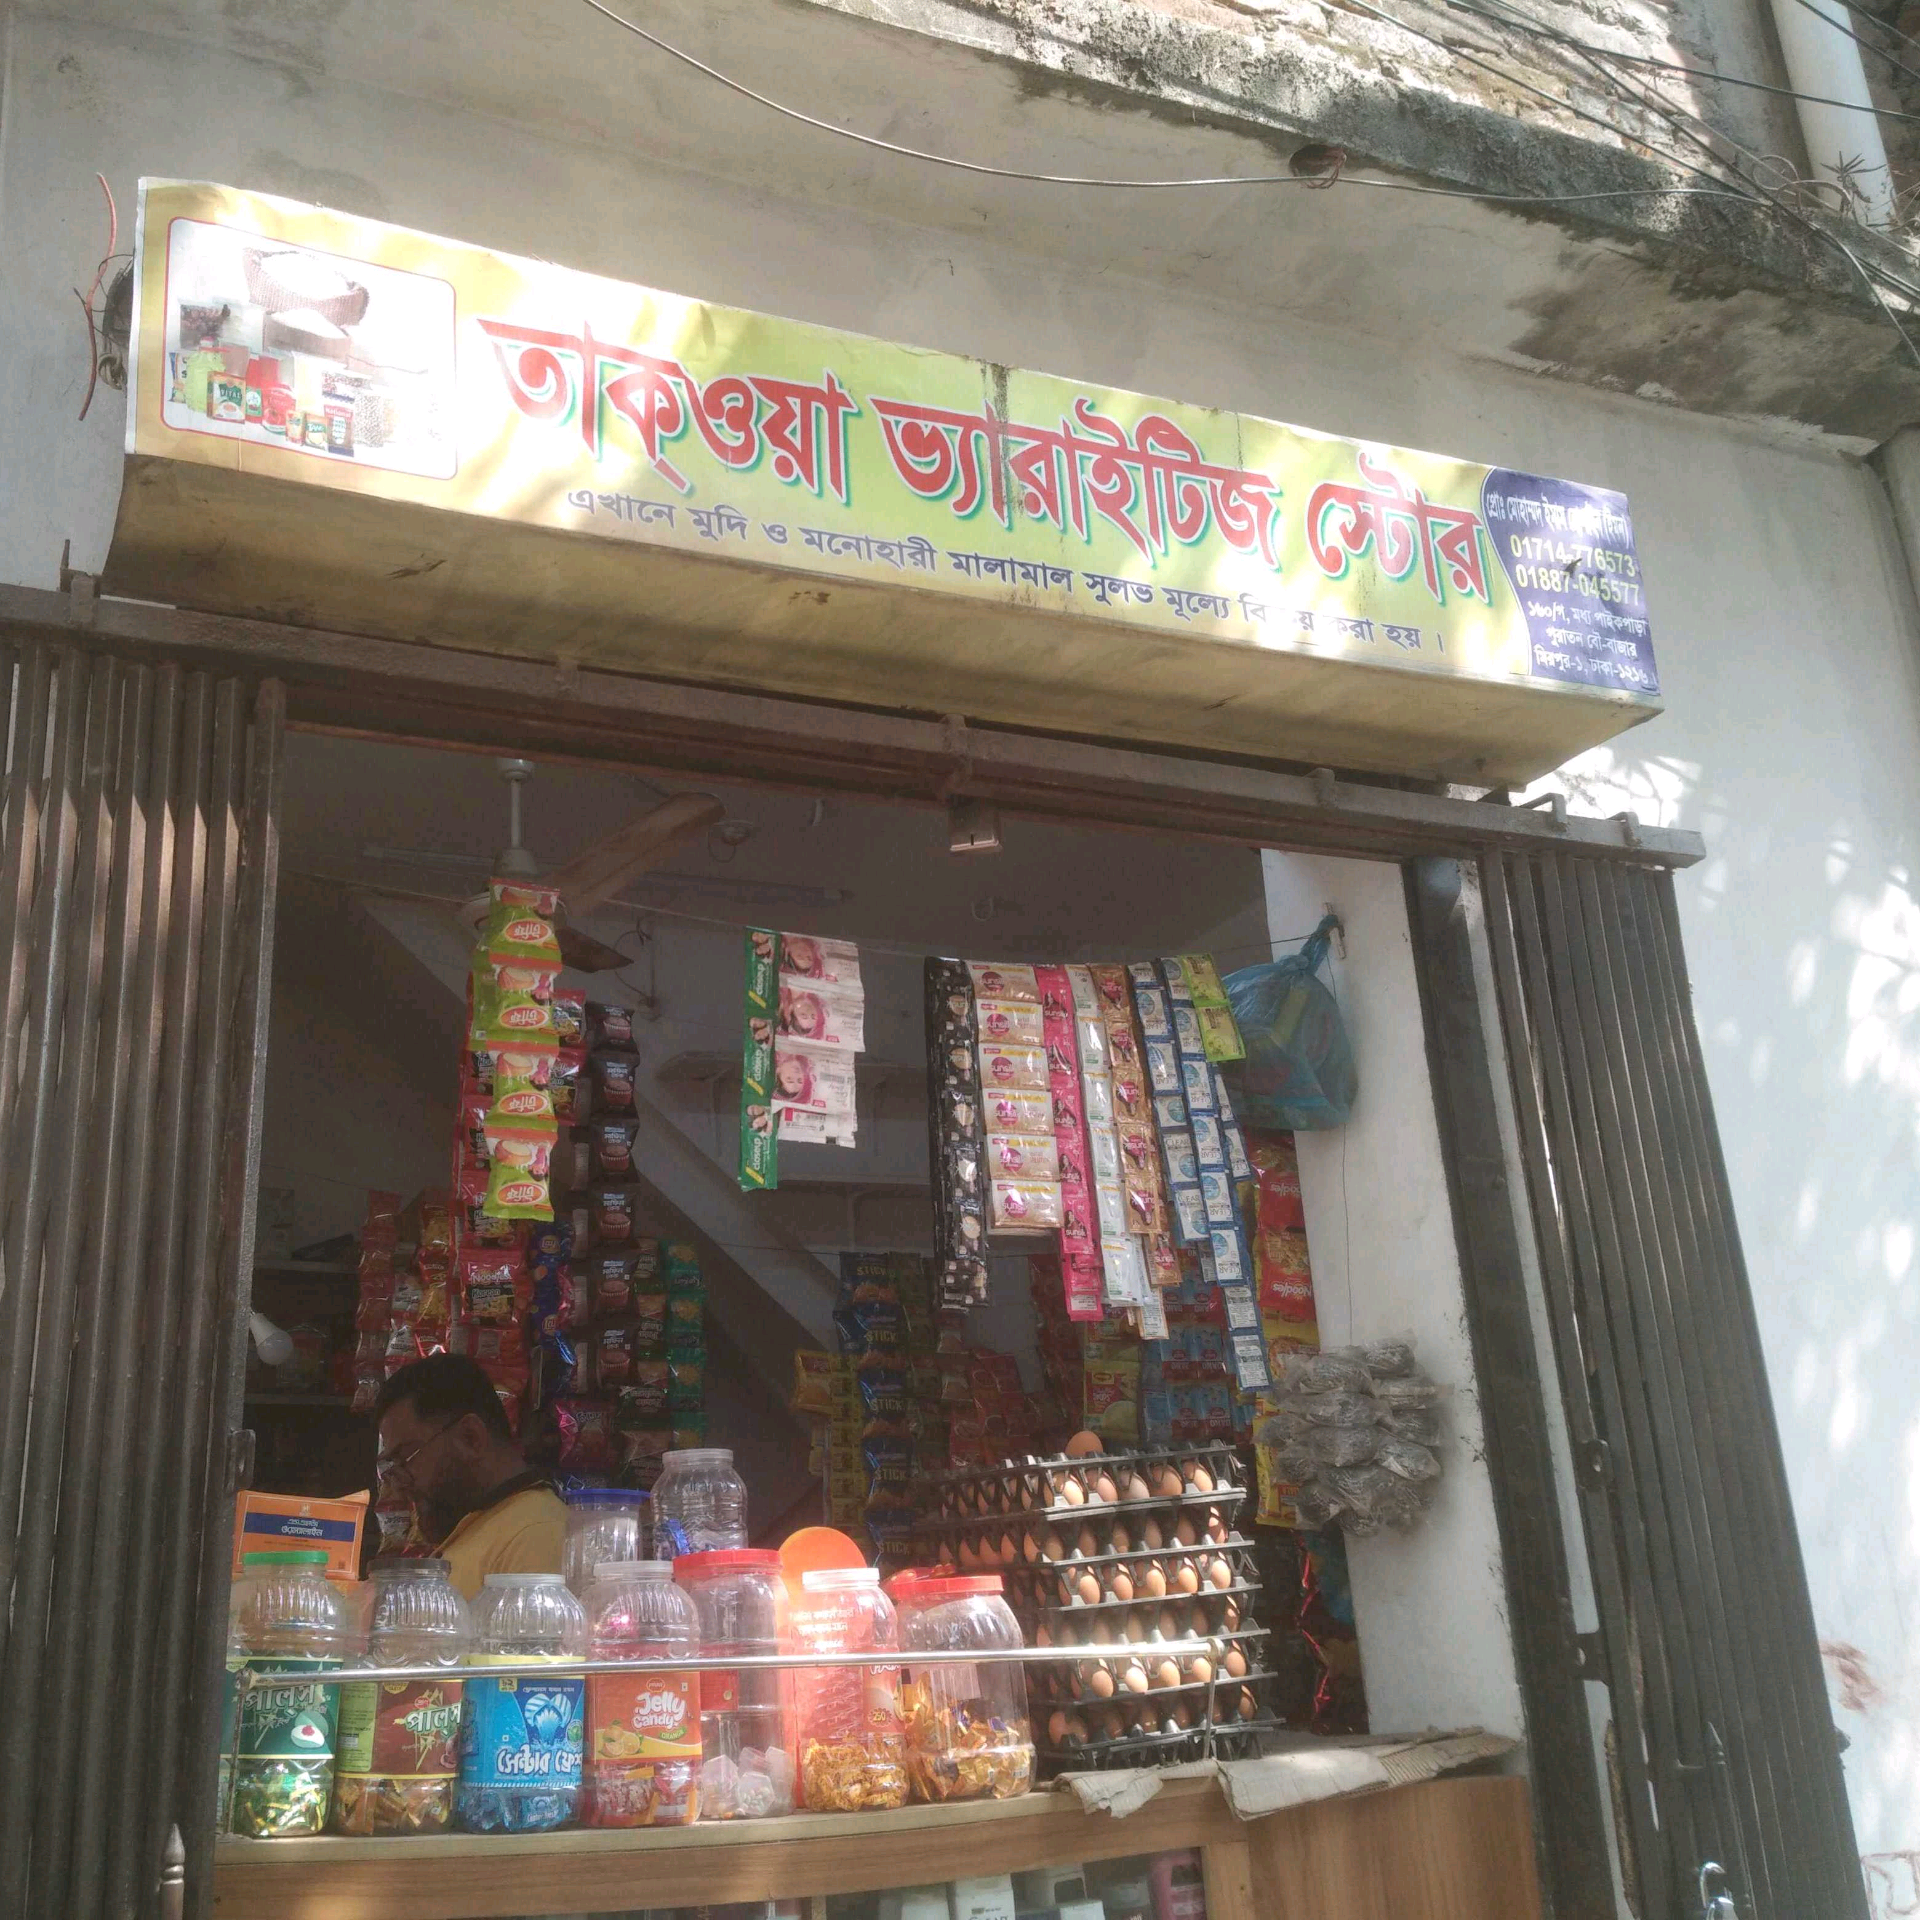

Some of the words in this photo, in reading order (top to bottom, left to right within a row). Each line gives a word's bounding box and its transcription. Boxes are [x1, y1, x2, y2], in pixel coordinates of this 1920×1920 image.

[869, 395, 1280, 566] ভ্যারাইটিজ
[1307, 453, 1490, 598] স্টোর
[1510, 534, 1636, 577] 01714-776573
[568, 491, 676, 530] এখানে
[690, 504, 749, 541] মুদি
[764, 521, 788, 544] ও
[802, 527, 939, 572] মনোহারী
[947, 550, 1072, 594] মালামাল
[1083, 572, 1154, 607] সুলভ
[1164, 585, 1229, 624] মূল্যে
[1381, 623, 1423, 652] হয়
[1516, 563, 1640, 606] 01887-045577
[1165, 1138, 1190, 1148] CLEAR
[1200, 1151, 1222, 1161] CLEAR
[1270, 1182, 1301, 1197] oodles
[1210, 1208, 1233, 1218] CLEAR
[1218, 1265, 1240, 1276] CLEAR
[1272, 1282, 1312, 1298] Noodles
[634, 1691, 687, 1722] Jelly
